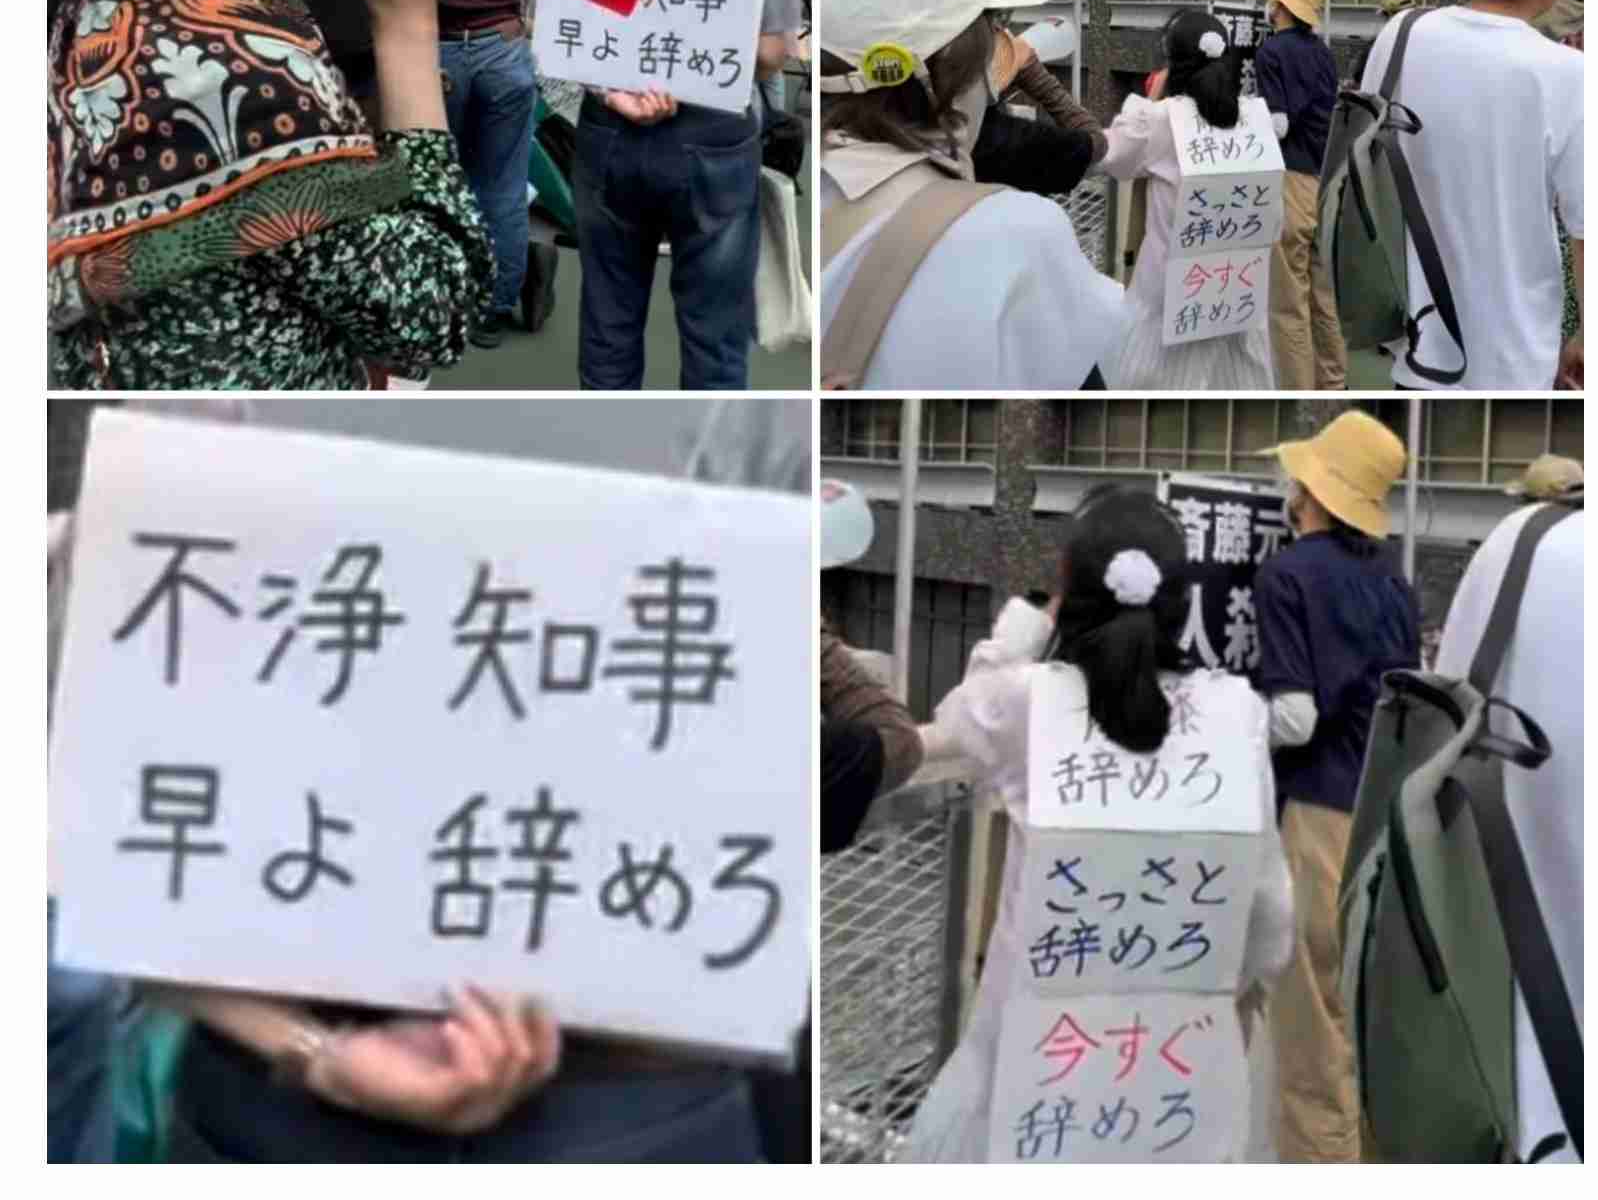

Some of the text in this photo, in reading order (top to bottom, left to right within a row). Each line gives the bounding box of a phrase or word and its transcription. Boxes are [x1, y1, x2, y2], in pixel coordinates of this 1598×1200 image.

[1186, 134, 1264, 165] 辞めろ
[1188, 185, 1271, 216] さっさと
[1179, 214, 1263, 248] 辞めろ
[1184, 256, 1263, 298] 今すぐ
[1175, 293, 1256, 335] 辞めろ
[1052, 752, 1223, 807] 辞めろ
[1044, 856, 1229, 914] さっさと
[1029, 921, 1213, 979] 辞めろ
[1034, 1012, 1215, 1086] 今すぐ
[1014, 1094, 1199, 1161] 辞めろ
